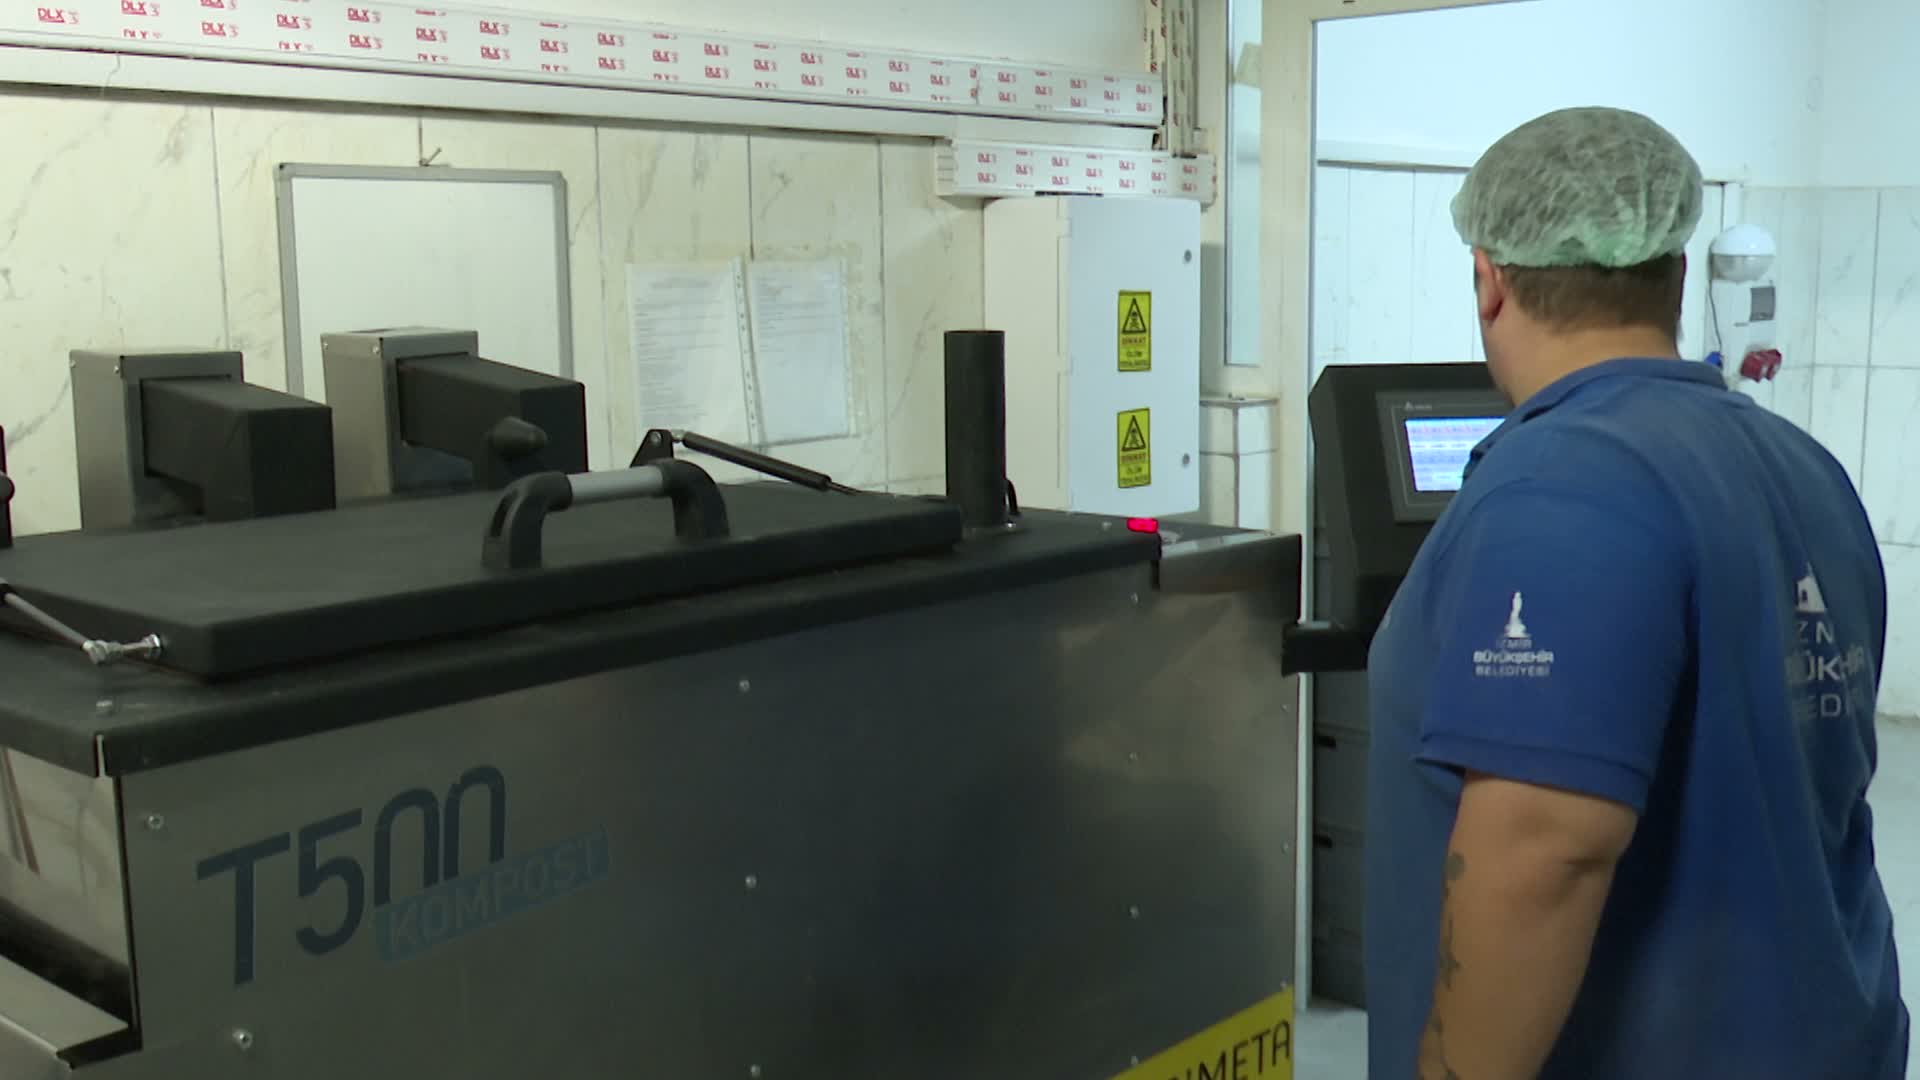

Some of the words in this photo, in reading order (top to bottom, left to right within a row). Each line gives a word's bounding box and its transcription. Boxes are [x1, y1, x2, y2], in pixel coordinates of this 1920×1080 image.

[38, 8, 64, 23] DLX
[277, 14, 300, 29] DLX
[202, 22, 226, 36] DLX
[388, 834, 605, 954] KOMPOST
